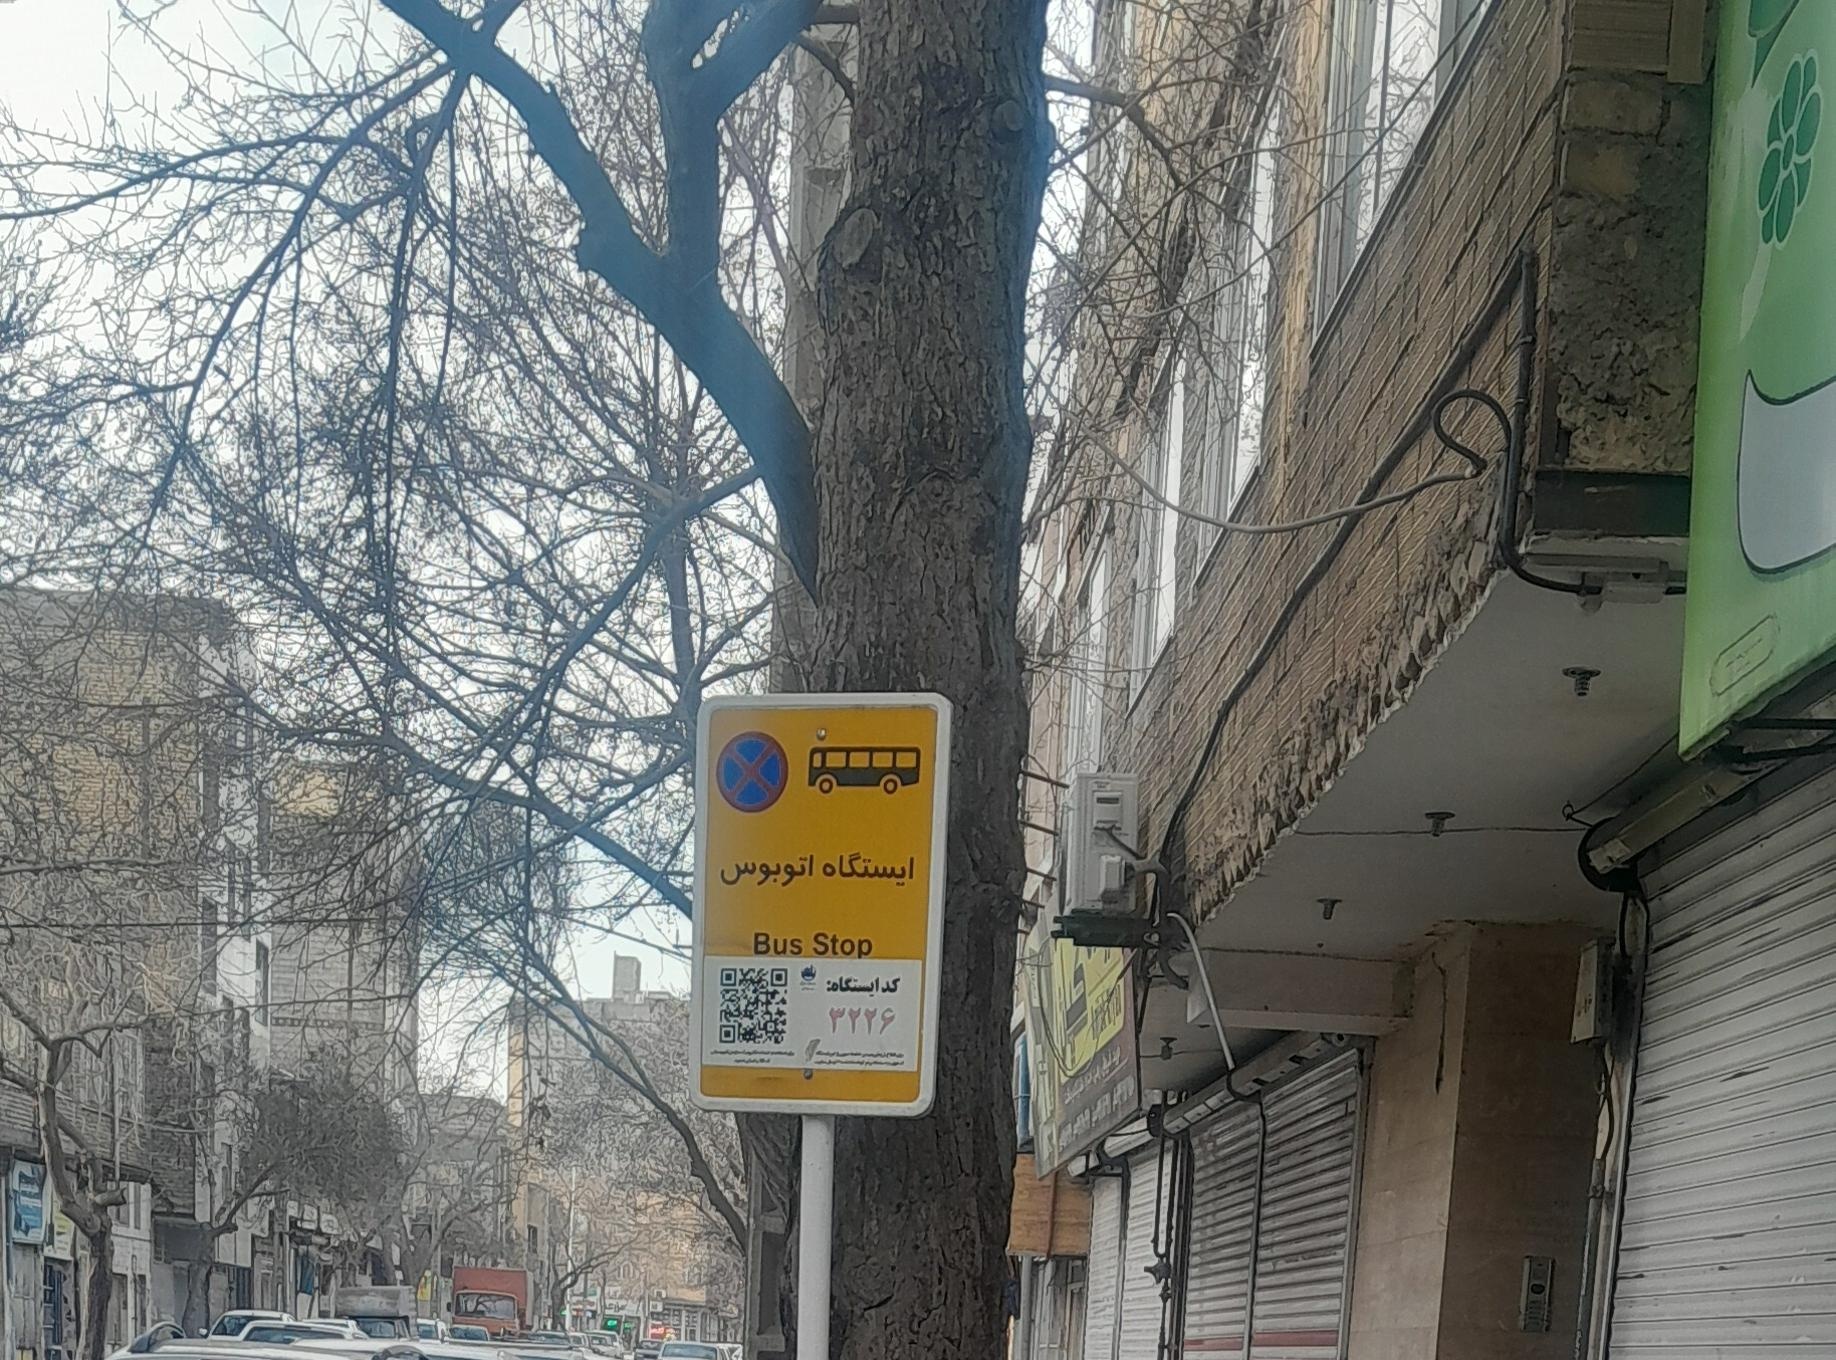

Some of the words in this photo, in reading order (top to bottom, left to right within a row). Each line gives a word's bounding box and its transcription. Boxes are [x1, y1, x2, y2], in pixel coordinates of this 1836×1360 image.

[720, 854, 814, 887] اتوبوس
[822, 852, 915, 887] ایستگاه
[753, 932, 803, 956] Bus
[812, 932, 873, 959] Stop
[826, 976, 880, 998] ایستگاه:
[881, 976, 901, 993] کد
[828, 1007, 896, 1036] ۳۲۲۶
